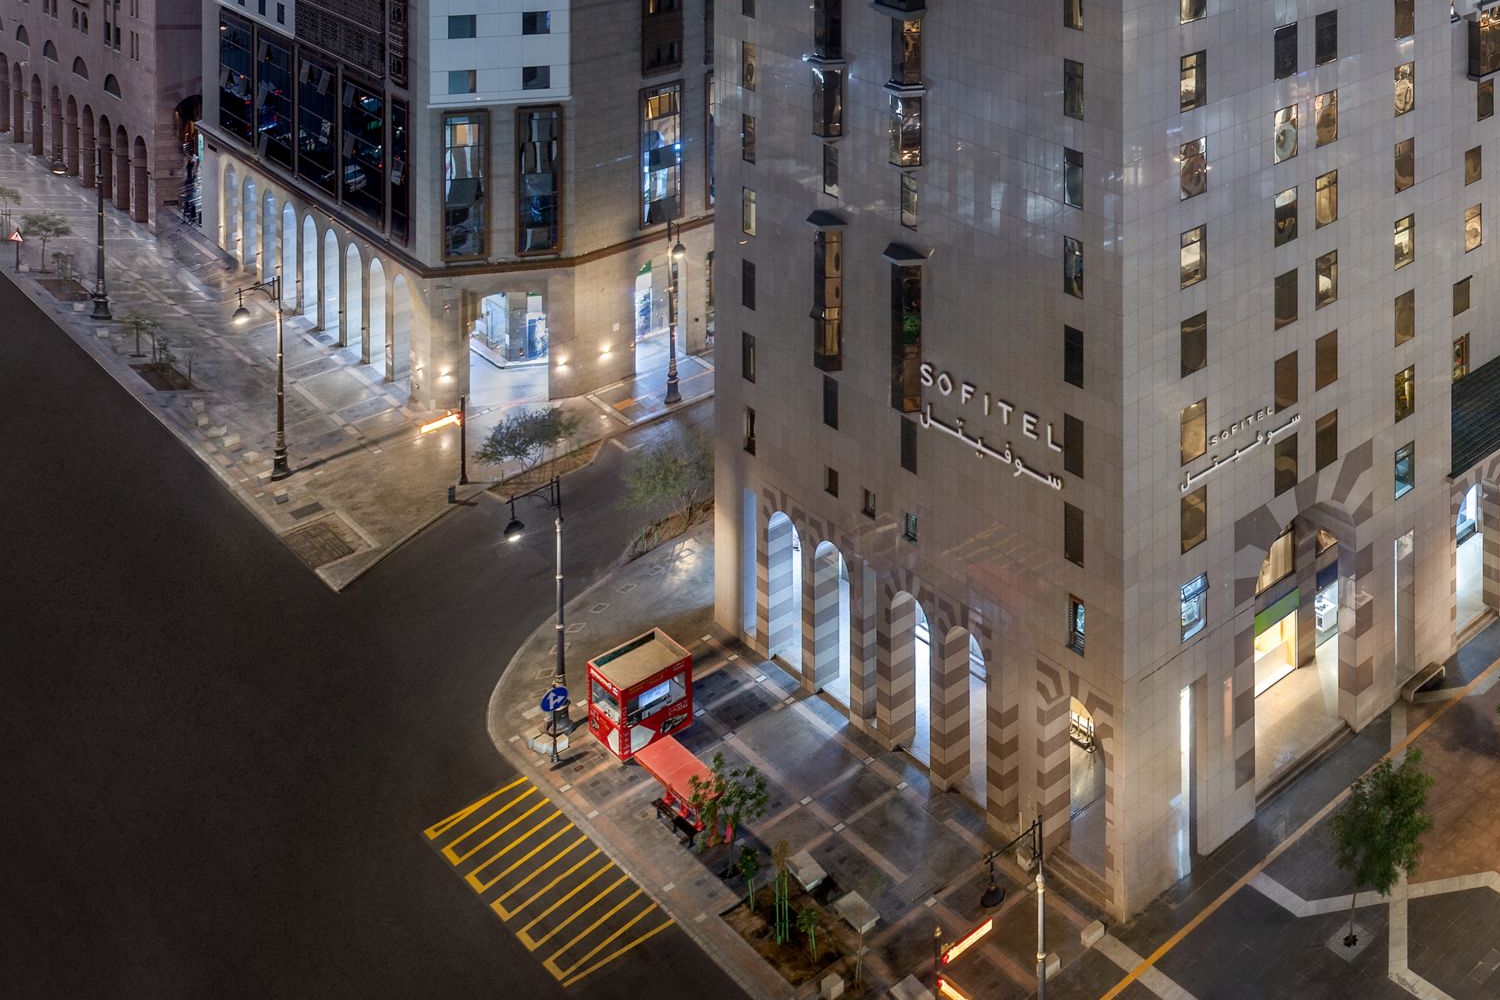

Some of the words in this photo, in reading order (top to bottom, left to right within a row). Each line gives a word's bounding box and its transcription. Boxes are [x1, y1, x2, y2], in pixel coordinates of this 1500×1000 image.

[920, 362, 1062, 453] SOFITEL
[920, 403, 1062, 490] سوفيتل
[1210, 406, 1274, 446] SOFITEL
[1181, 415, 1300, 491] سوفيتل
